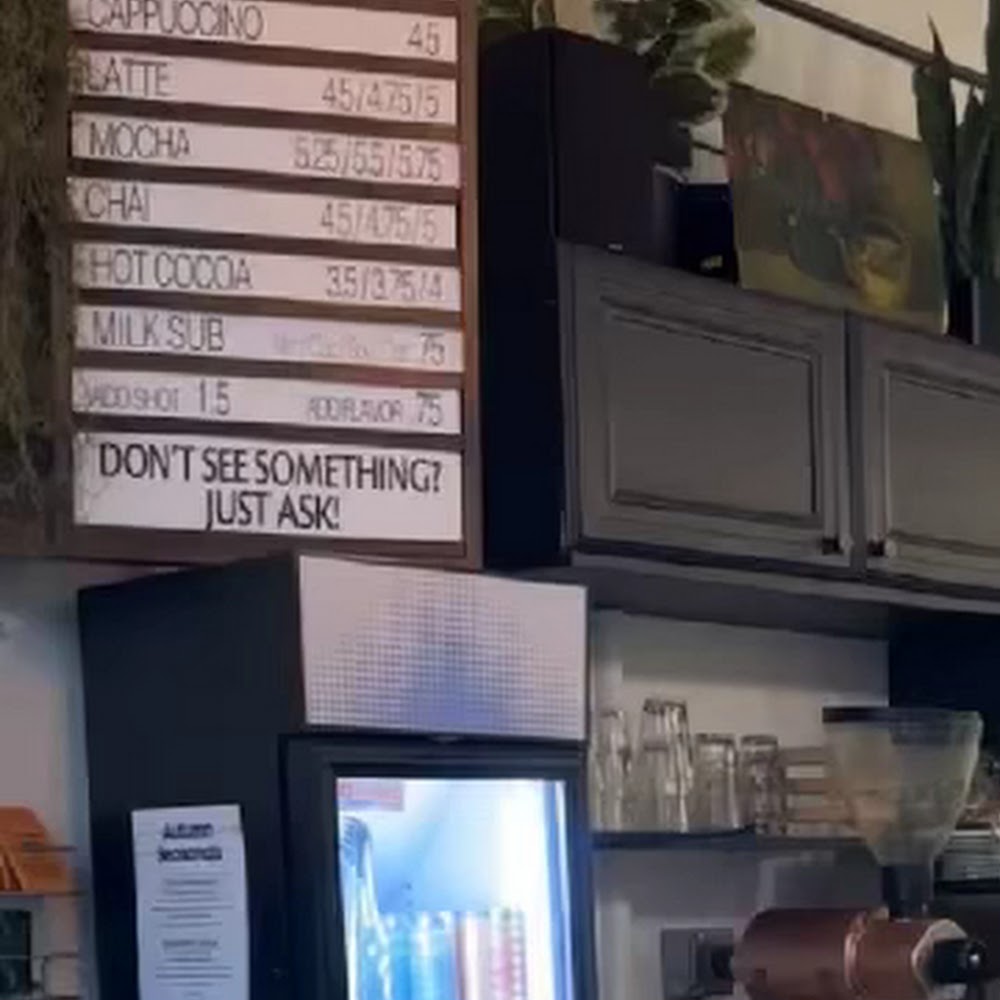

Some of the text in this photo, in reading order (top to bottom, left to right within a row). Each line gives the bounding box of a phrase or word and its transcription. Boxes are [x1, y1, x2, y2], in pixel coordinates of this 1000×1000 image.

[87, 56, 173, 96] LATTE
[89, 121, 190, 158] MOCHA
[85, 182, 150, 221] CHAI
[89, 246, 148, 285] HOT
[153, 250, 253, 290] COCOA
[92, 310, 160, 348] MILK
[166, 314, 225, 351] SUB
[99, 441, 442, 493] DON'T SEE SOMETHING?
[205, 489, 341, 530] JUST ASK!
